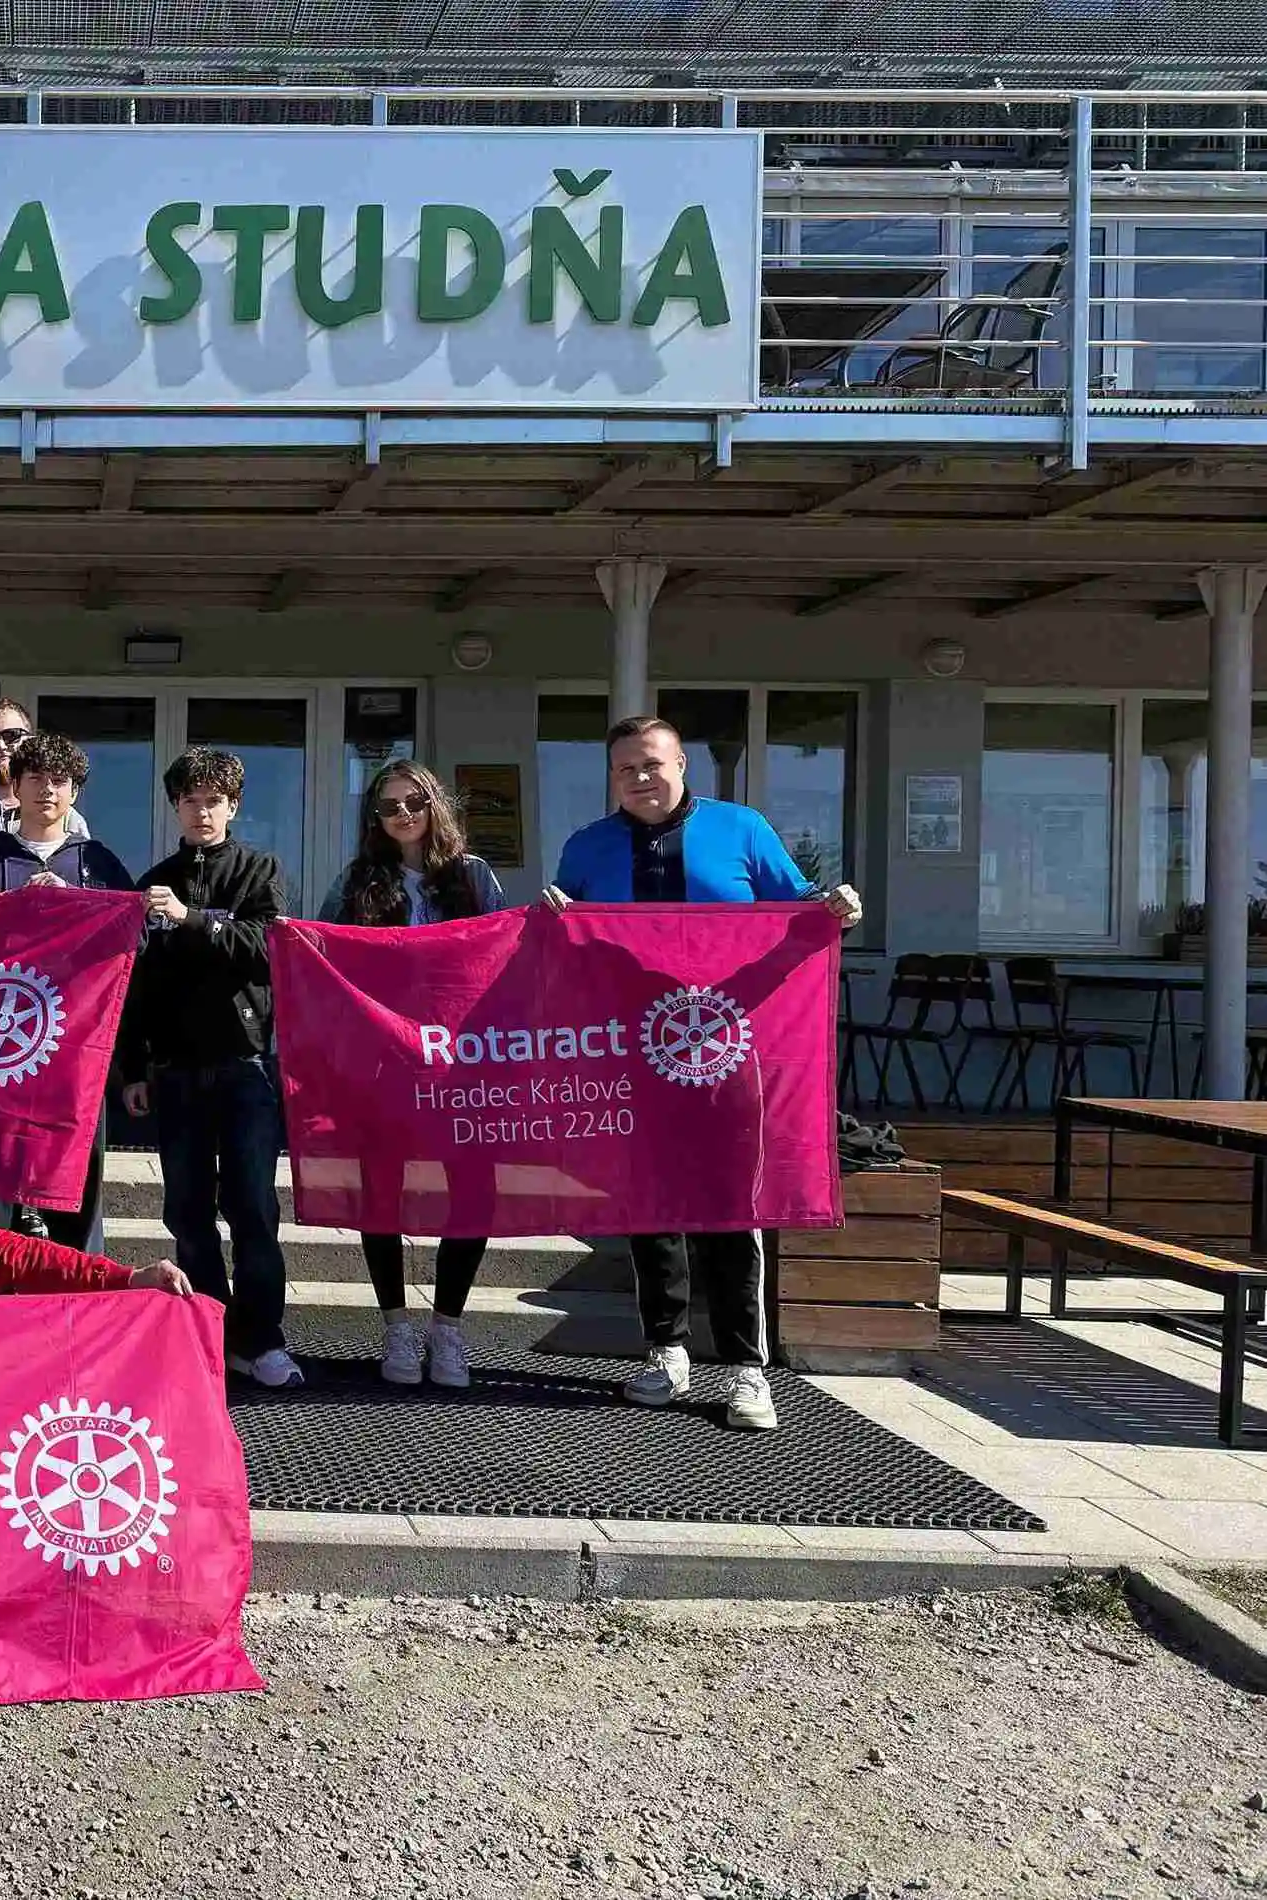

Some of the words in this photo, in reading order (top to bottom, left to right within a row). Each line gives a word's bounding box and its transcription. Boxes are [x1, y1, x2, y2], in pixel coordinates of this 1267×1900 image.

[139, 168, 731, 327] STUDŇA
[420, 1018, 628, 1066] Rotaract
[415, 1080, 520, 1110] Hradec
[531, 1073, 633, 1107] Králové
[453, 1115, 554, 1145] District
[564, 1108, 634, 1140] 2240
[51, 1417, 122, 1436] ROTARY
[28, 1508, 154, 1553] INTERNATIONAL
